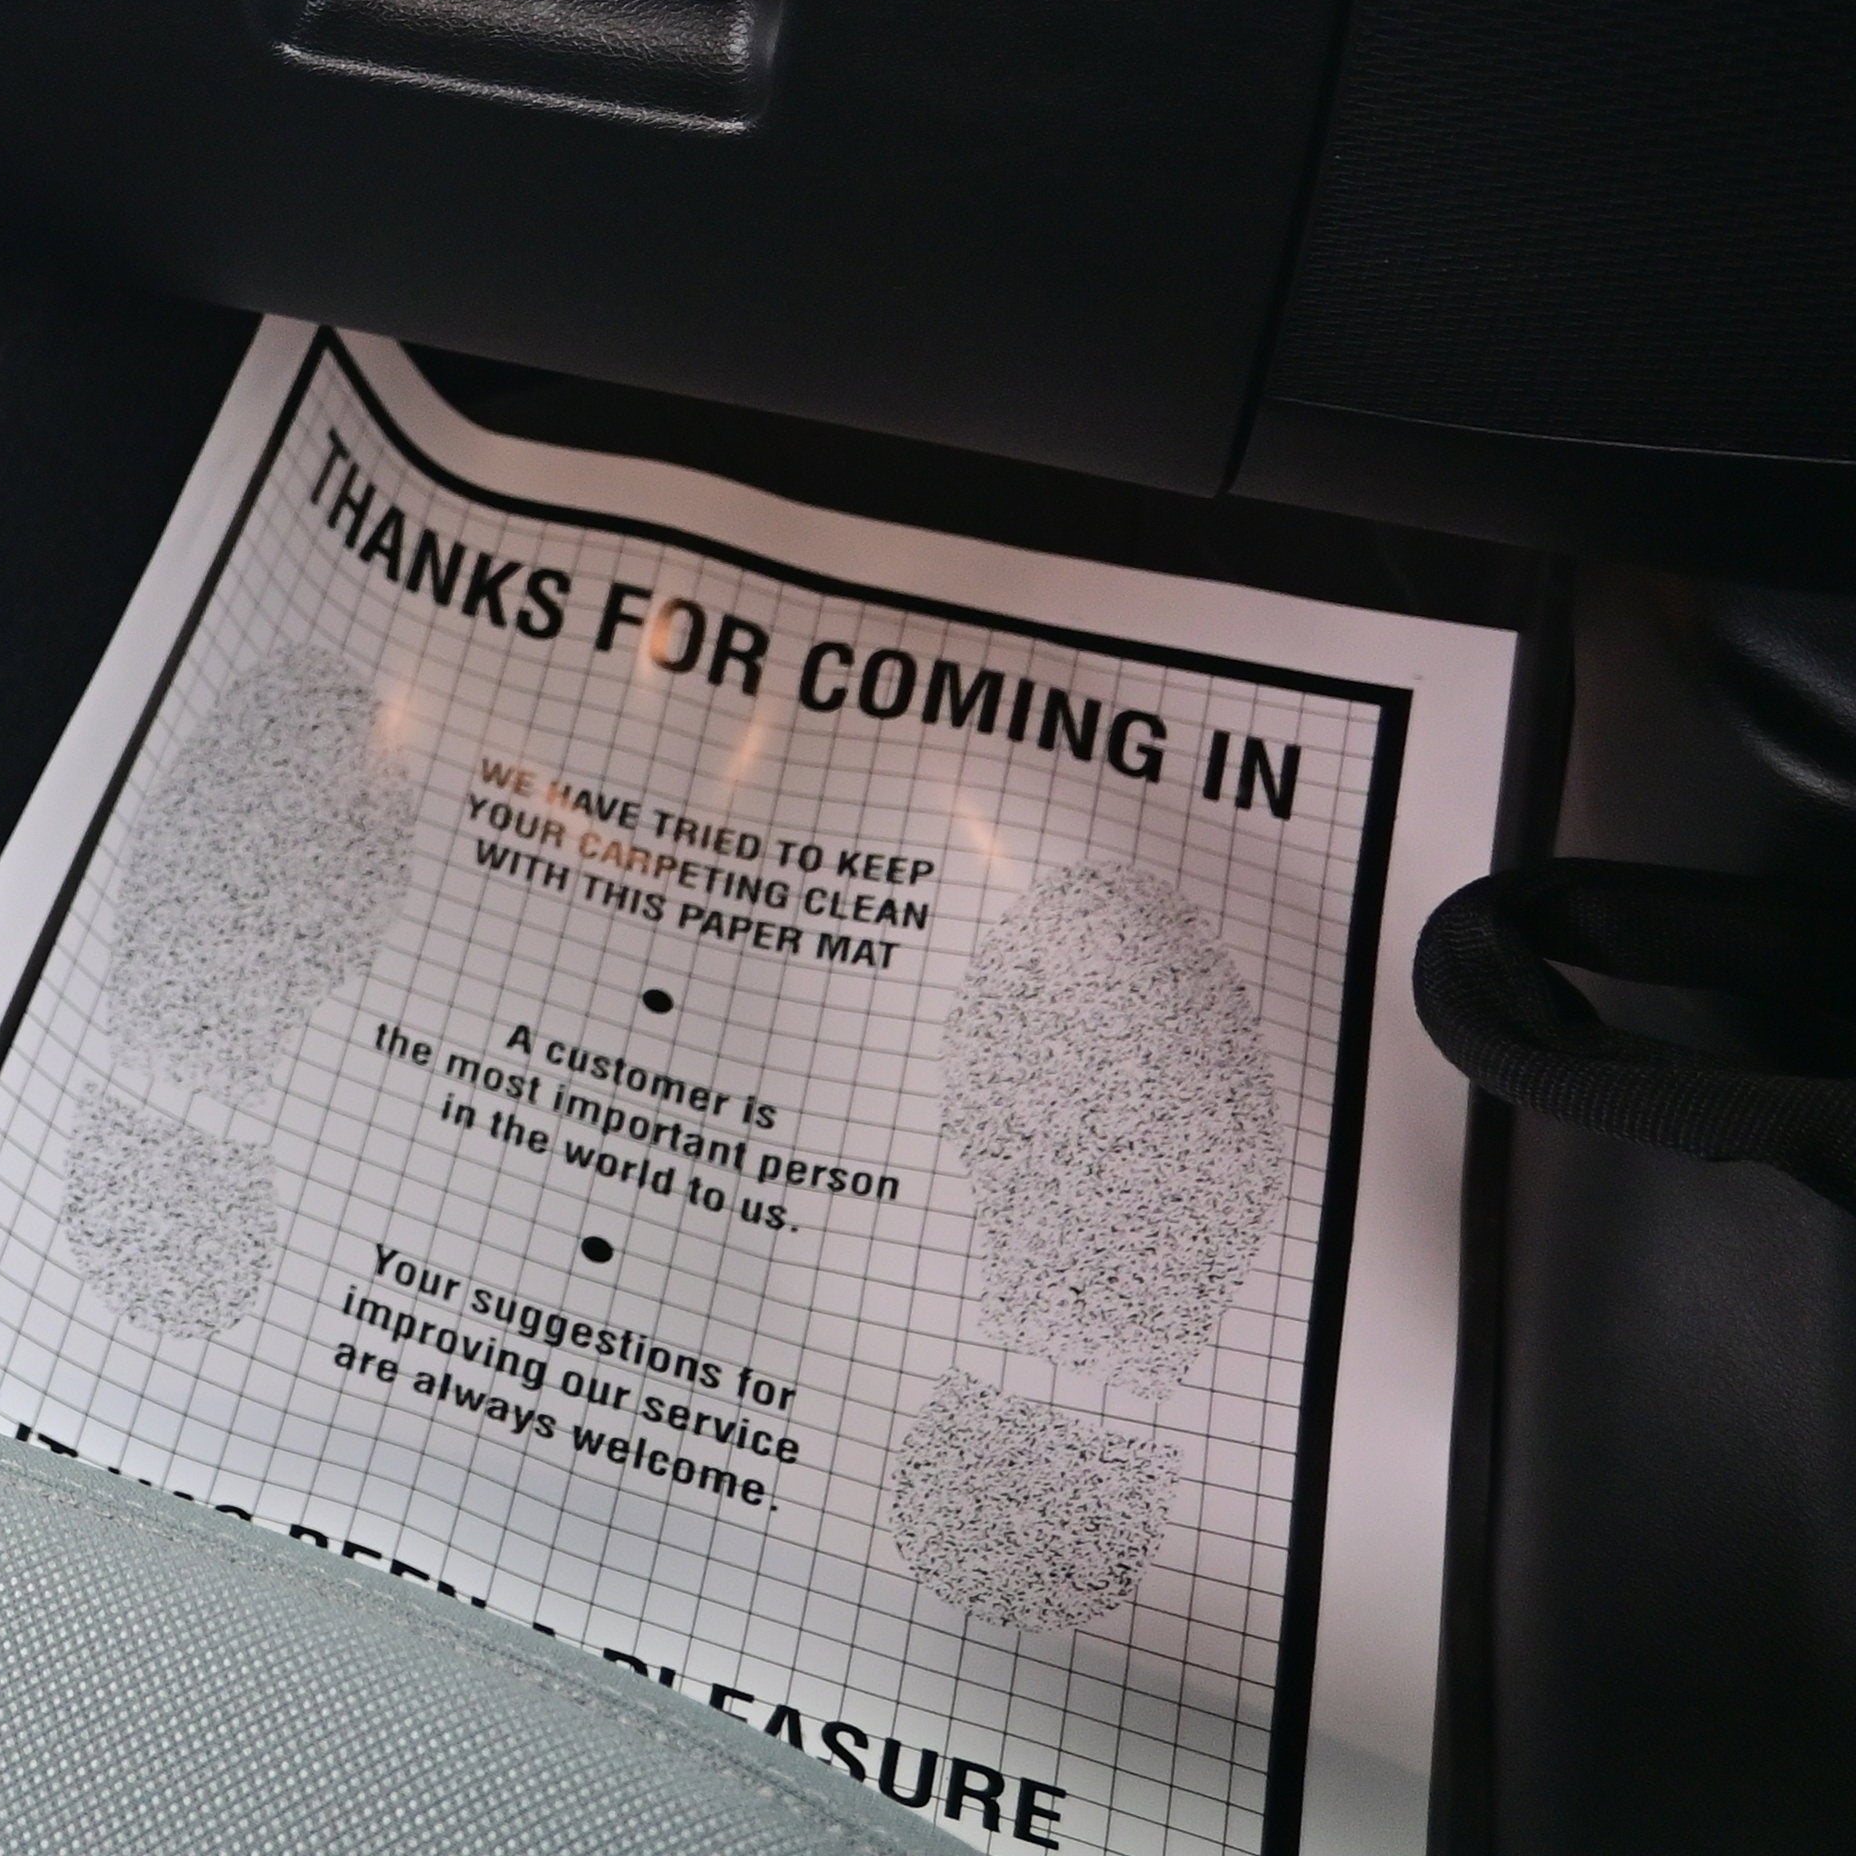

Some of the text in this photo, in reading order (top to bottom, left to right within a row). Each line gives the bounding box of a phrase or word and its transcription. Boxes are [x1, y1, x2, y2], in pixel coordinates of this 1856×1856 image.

[310, 428, 1301, 820] THANKS FOR COMING IN
[466, 794, 930, 930] YOUR CARPETING CLEAN
[479, 758, 935, 886] WE HAVE TRIED TO KEEP
[475, 839, 900, 970] WITH THIS PAPER MAT
[375, 1023, 900, 1202] the most important person
[505, 1024, 777, 1130] A customer is
[441, 1093, 799, 1233] in the world to us.
[341, 1285, 800, 1465] improving our service
[371, 1243, 797, 1411] Your suggestions for
[333, 1341, 780, 1511] are always welcome.
